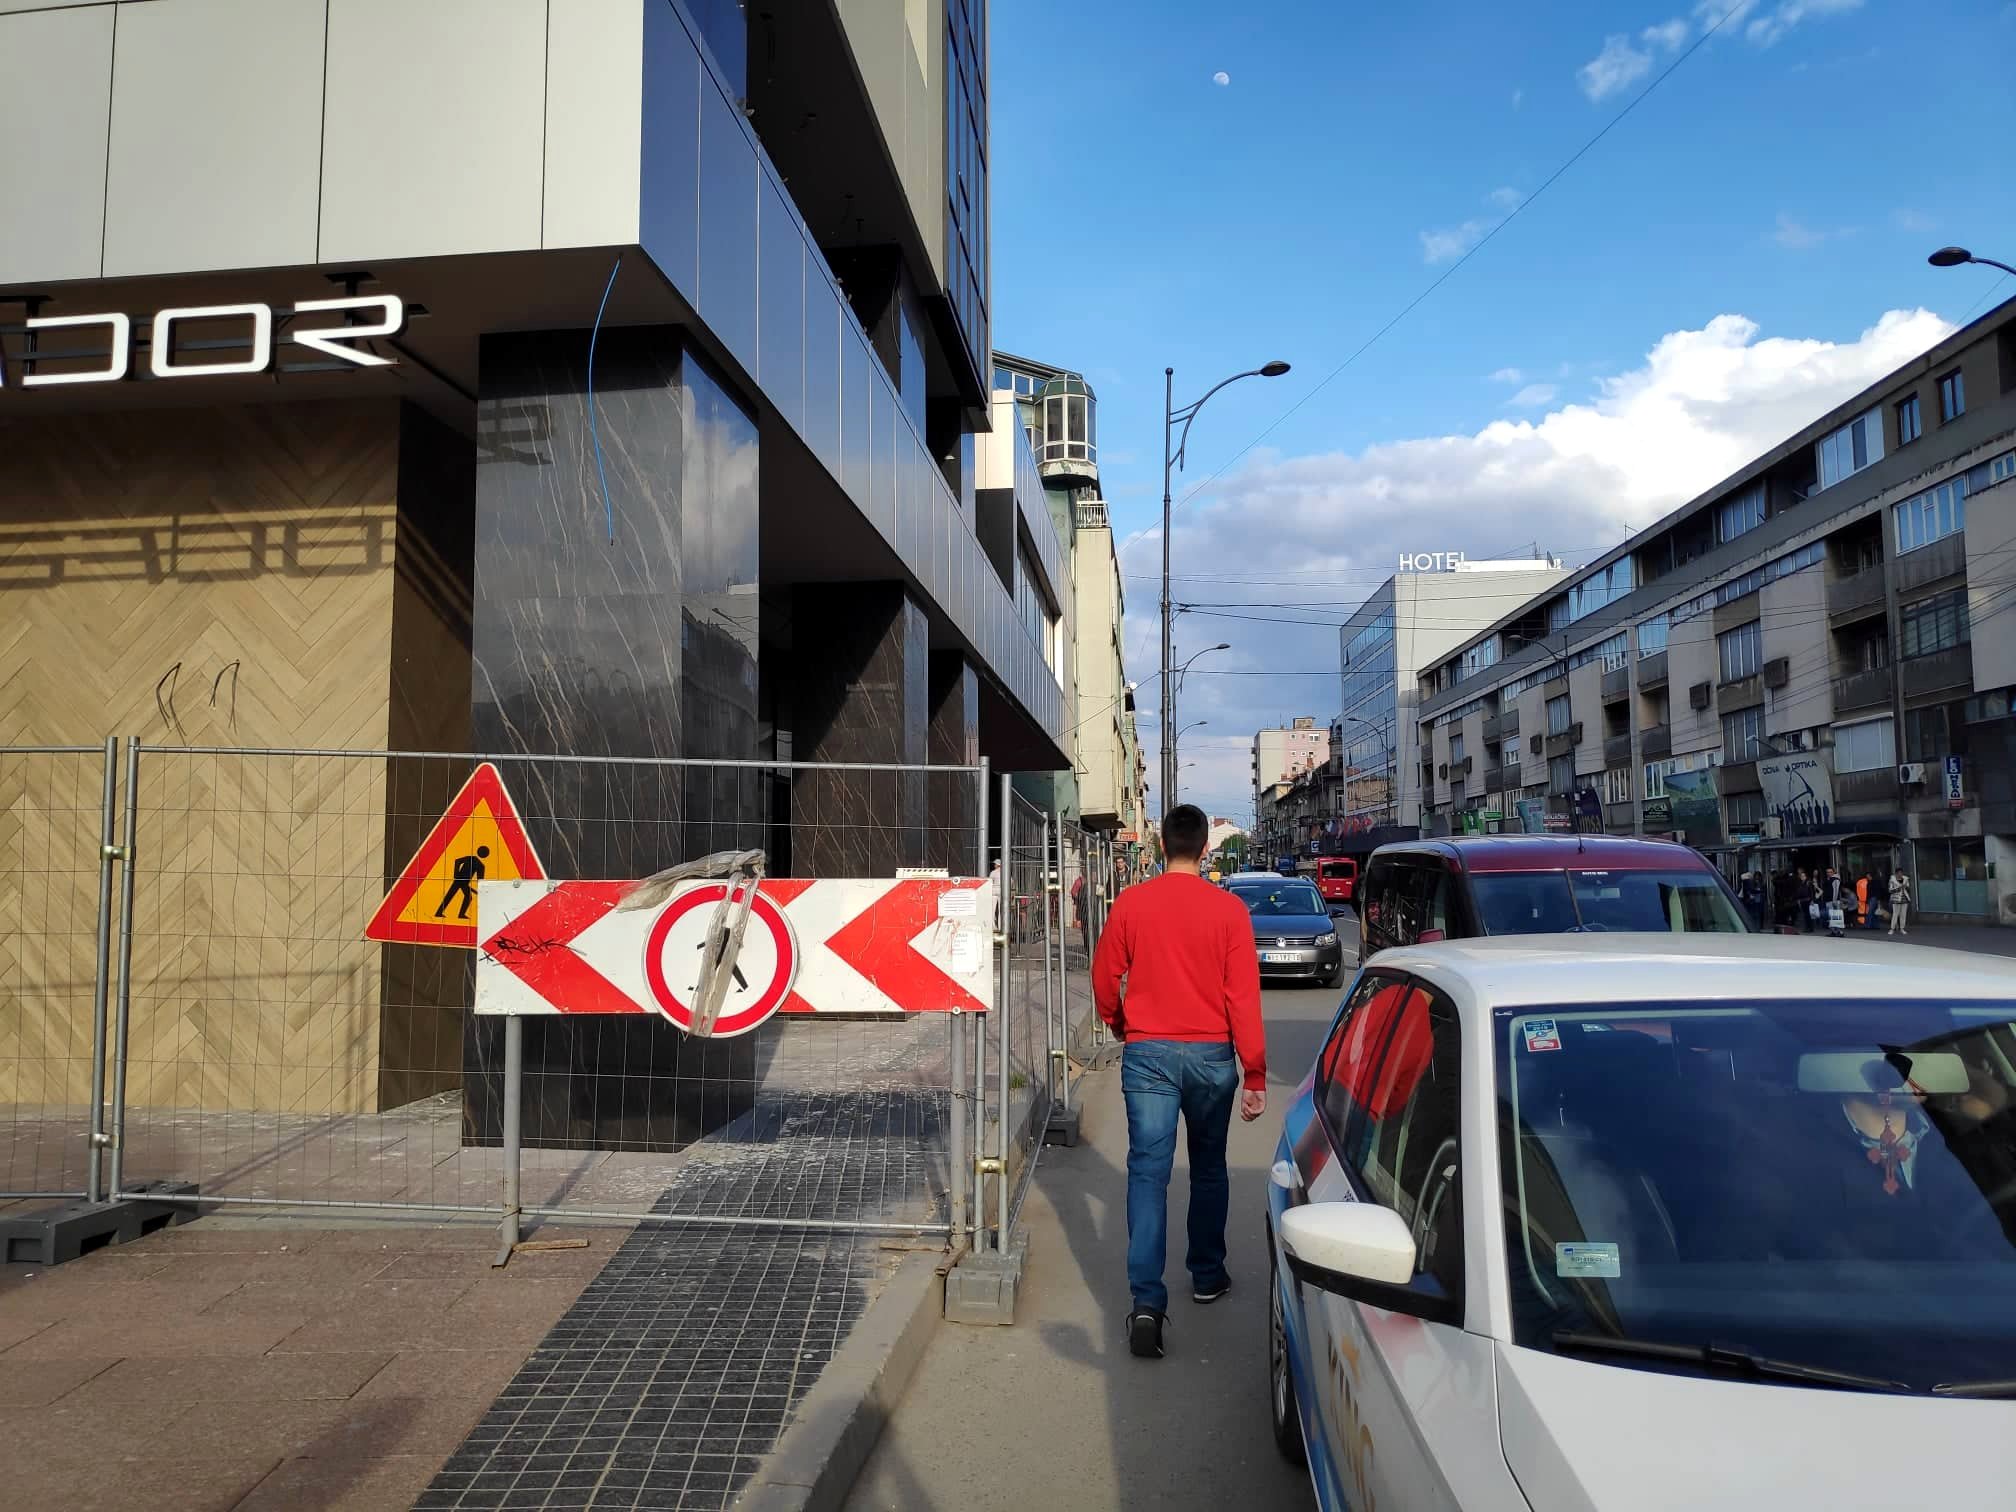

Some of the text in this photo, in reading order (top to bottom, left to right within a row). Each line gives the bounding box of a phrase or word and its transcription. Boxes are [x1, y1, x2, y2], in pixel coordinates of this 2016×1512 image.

[0, 295, 403, 388] DOR
[1399, 551, 1471, 571] HOTEL
[1791, 760, 1818, 770] OPTIKA
